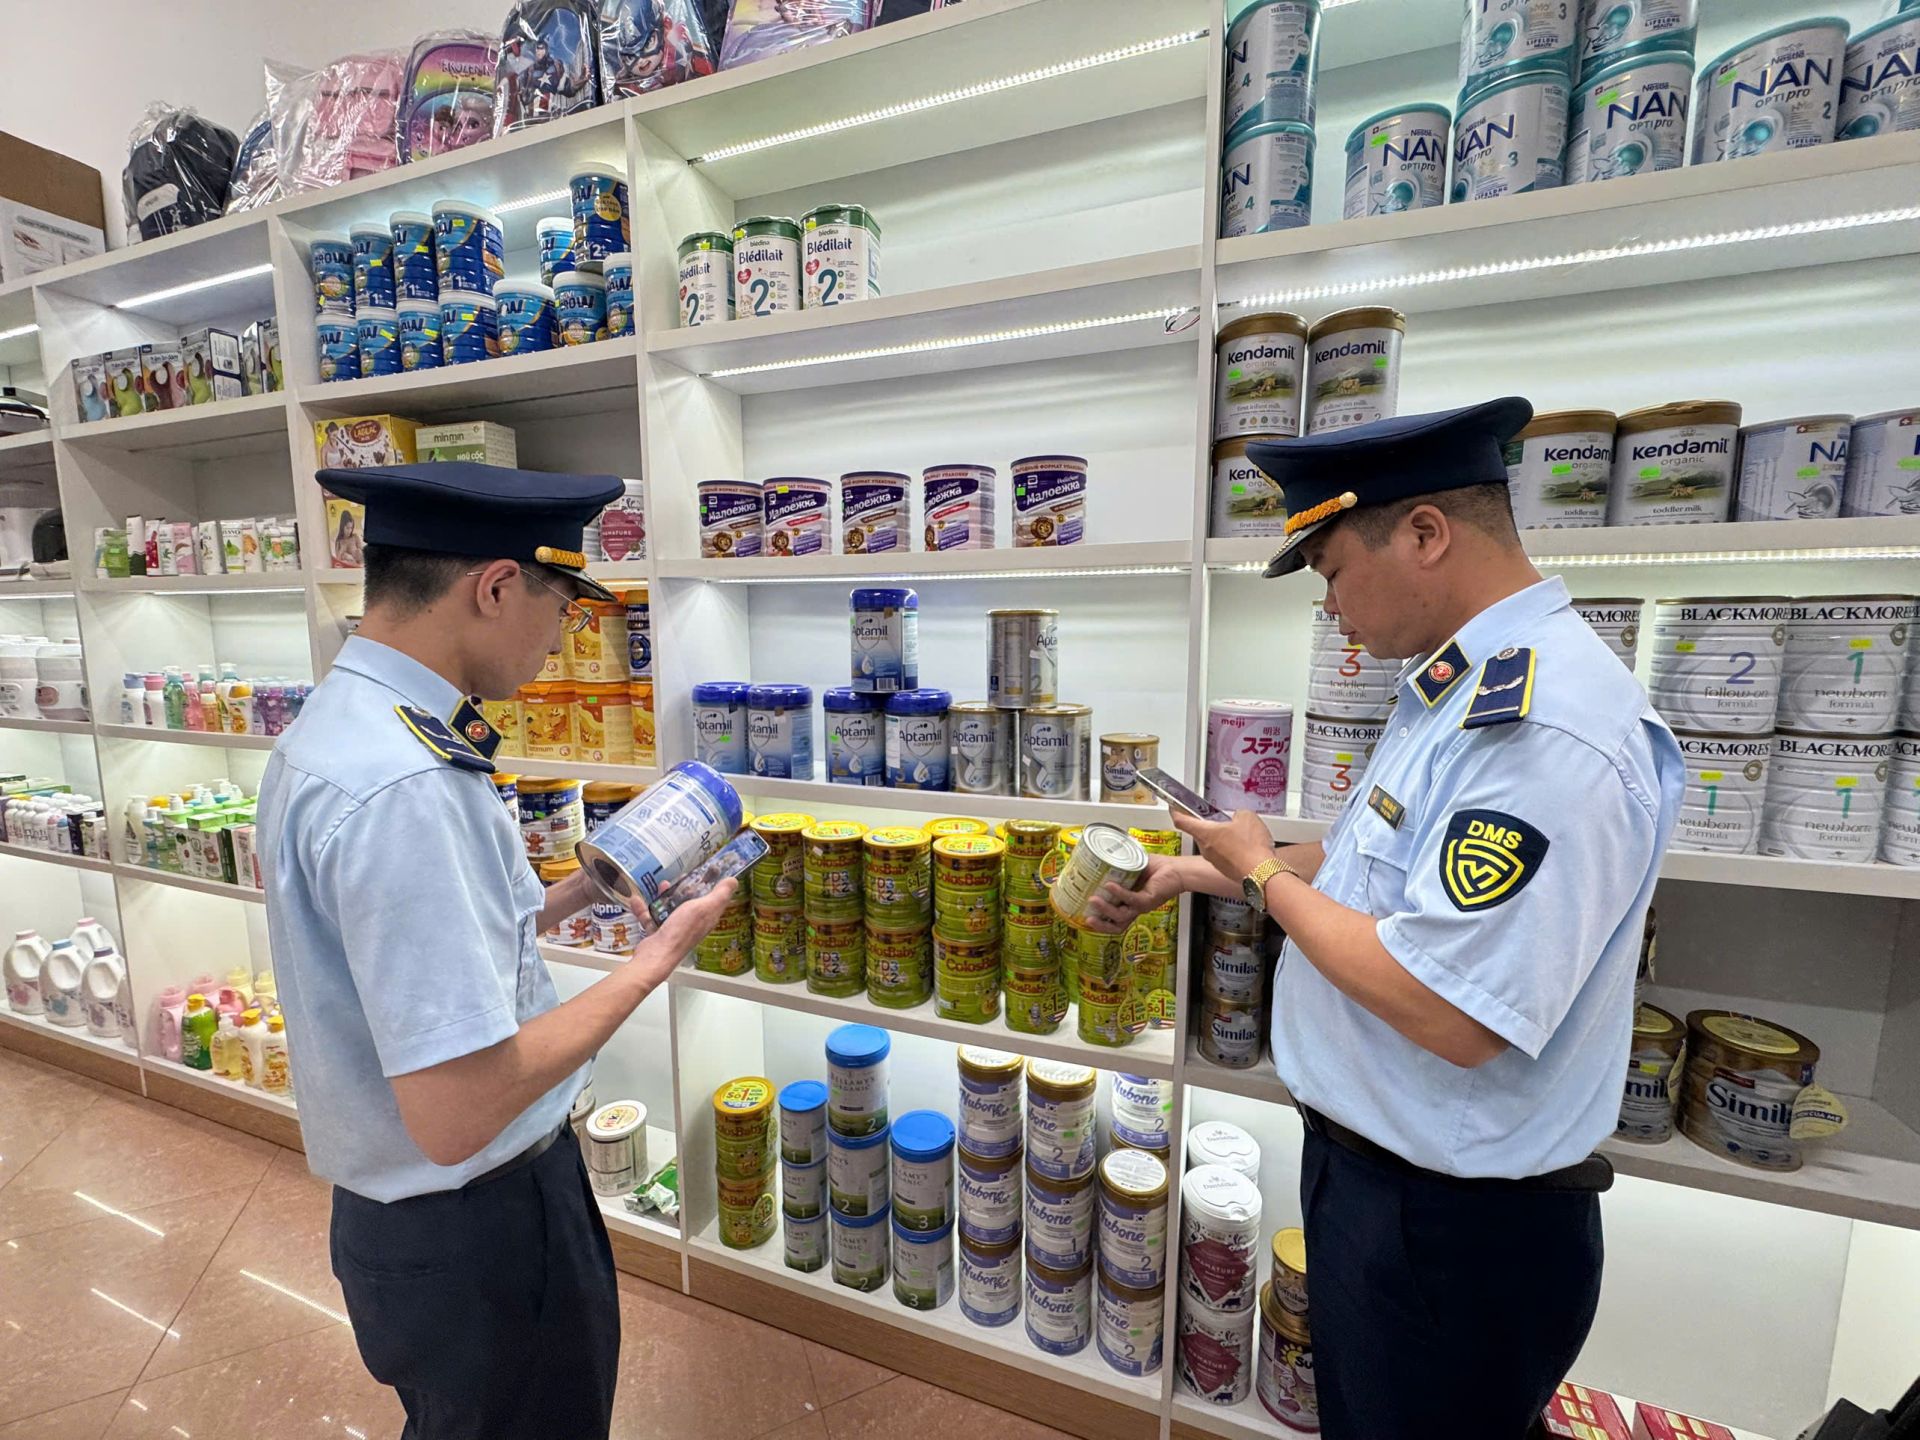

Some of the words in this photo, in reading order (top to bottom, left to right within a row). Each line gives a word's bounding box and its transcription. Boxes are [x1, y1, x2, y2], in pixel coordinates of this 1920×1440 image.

[1731, 57, 1833, 110] NAN
[1606, 93, 1688, 130] NAN
[1822, 101, 1832, 121] 2
[1508, 151, 1519, 167] 3
[1244, 195, 1256, 211] 4
[807, 238, 853, 256] Blédilait
[738, 250, 784, 265] Blédilait
[750, 278, 771, 317] 2
[818, 268, 839, 307] 2
[686, 291, 700, 327] 2
[1227, 345, 1296, 366] Kendamil
[1315, 339, 1388, 365] Kendamil
[1633, 437, 1729, 461] Kendamil
[1026, 479, 1081, 506] Малоежка
[1338, 649, 1362, 678] 3
[1725, 651, 1757, 685] 2
[1845, 650, 1865, 684] 1
[834, 725, 876, 740] Aptamil
[1221, 716, 1246, 729] meiji
[899, 729, 942, 744] Aptamil
[951, 730, 996, 747] Aptamil
[1022, 731, 1070, 747] Aptamil
[1329, 763, 1352, 792] 3
[1702, 784, 1718, 817] 1
[1835, 786, 1852, 819] 1
[1466, 819, 1524, 850] DMS
[1212, 955, 1261, 975] Similac
[1211, 1021, 1259, 1042] Similac
[1112, 1076, 1160, 1106] Nubone
[866, 1117, 877, 1133] 2
[1153, 1118, 1164, 1132] 2
[1052, 1147, 1063, 1163] 2
[841, 1199, 850, 1214] 2
[918, 1215, 929, 1229] 3
[1140, 1255, 1153, 1272] 2
[858, 1276, 869, 1291] 2
[1123, 1344, 1135, 1360] 2
